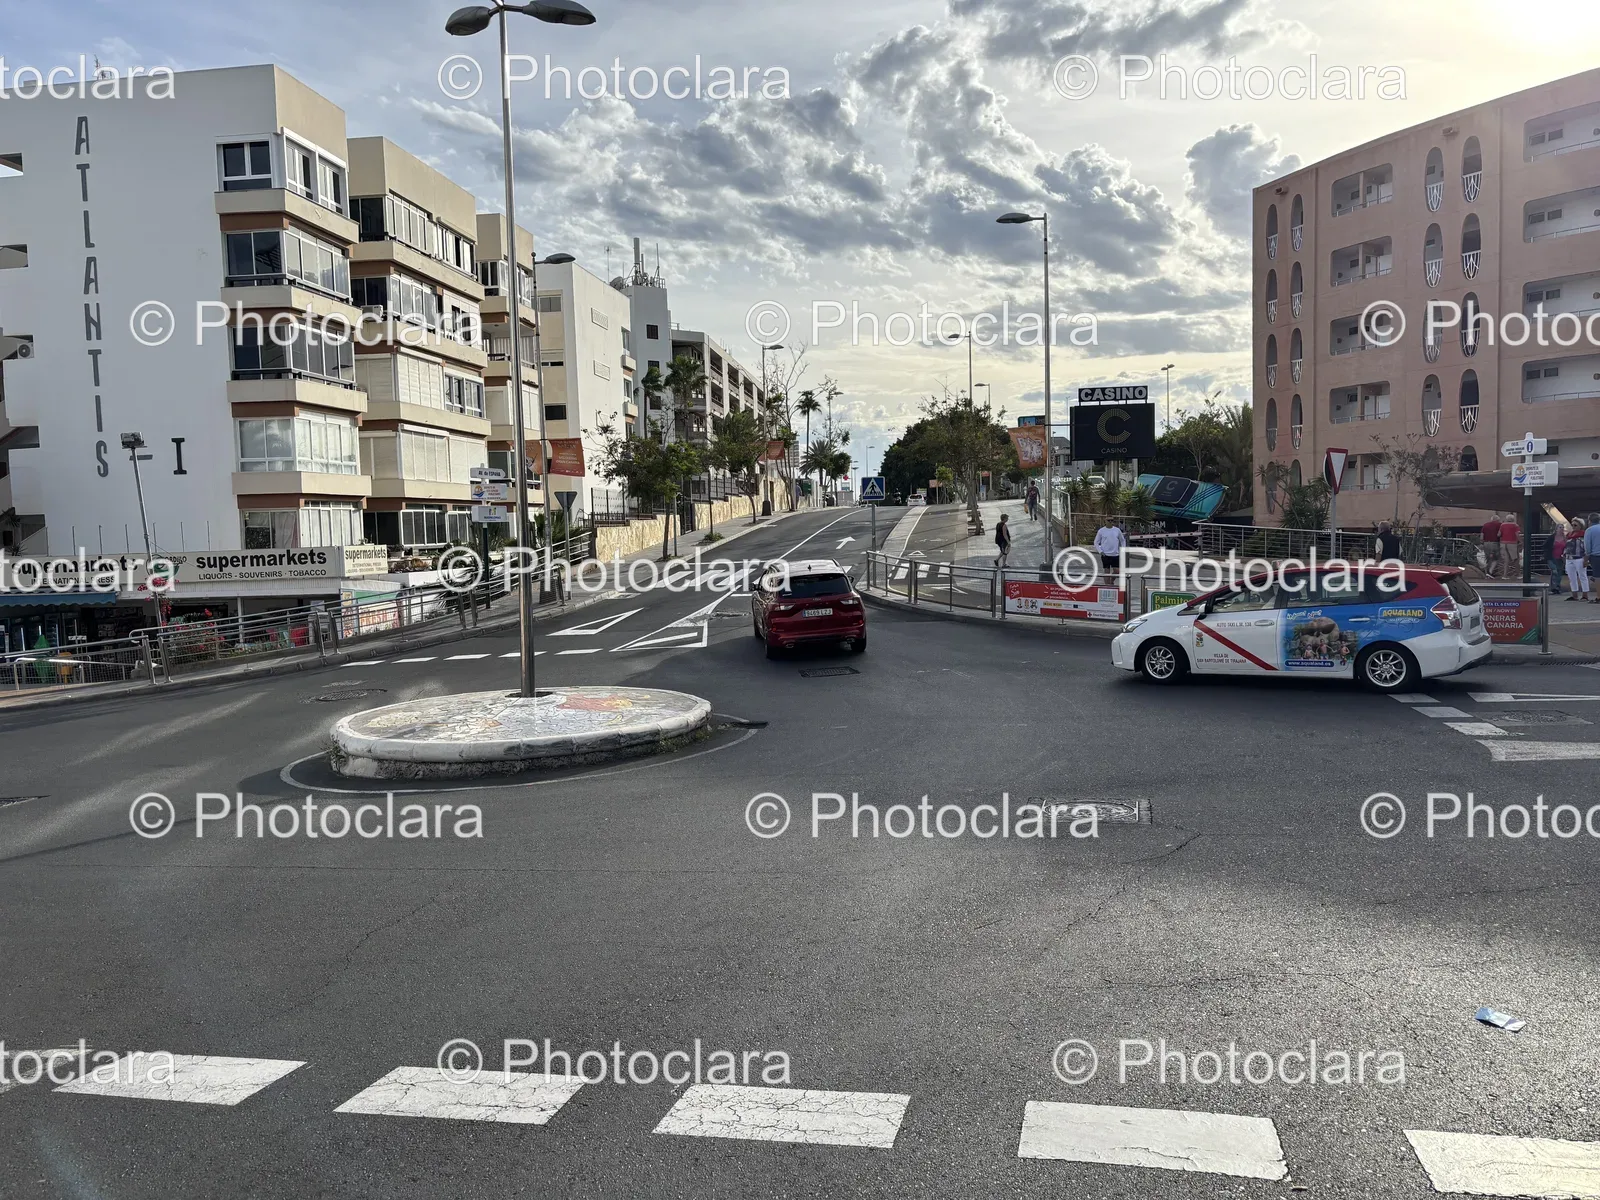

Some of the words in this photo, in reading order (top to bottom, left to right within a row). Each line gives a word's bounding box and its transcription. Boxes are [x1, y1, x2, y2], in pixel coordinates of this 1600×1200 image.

[1080, 386, 1147, 401] CASINO
[196, 549, 327, 572] supermarkets
[345, 546, 386, 562] supermarkets
[239, 570, 283, 579] SOUVENIRS
[289, 569, 327, 577] TOBACCO
[1382, 609, 1424, 617] AQUALAND
